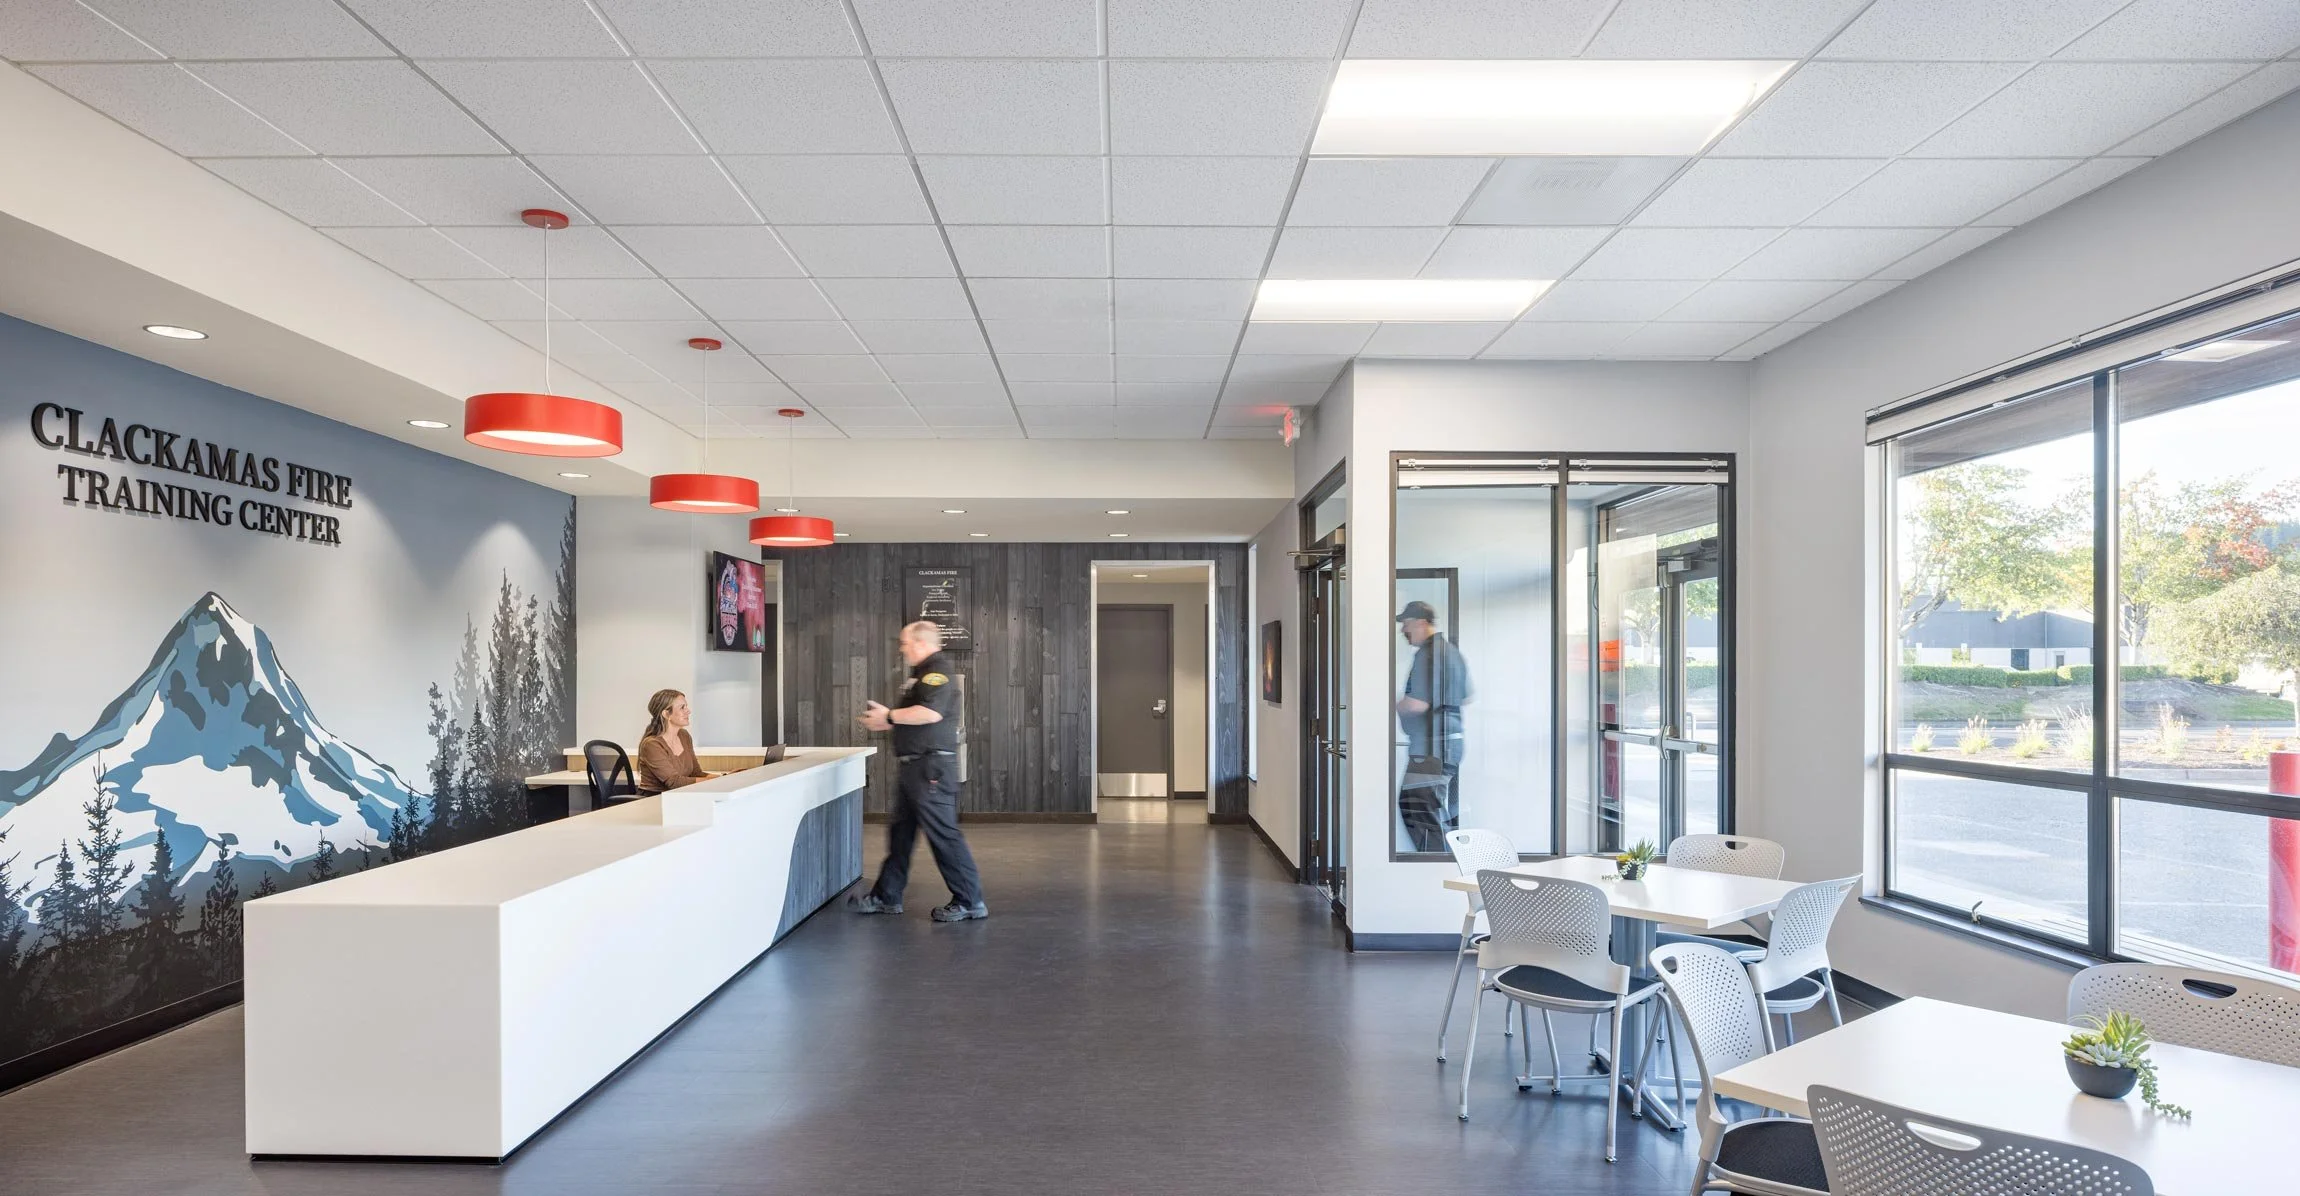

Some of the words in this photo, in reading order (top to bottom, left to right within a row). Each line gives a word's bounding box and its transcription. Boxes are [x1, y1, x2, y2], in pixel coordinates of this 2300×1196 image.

[31, 402, 280, 493] CLACKAMAS
[287, 462, 353, 509] FIRE
[57, 464, 233, 526] TRAINING
[239, 499, 342, 544] CENTER
